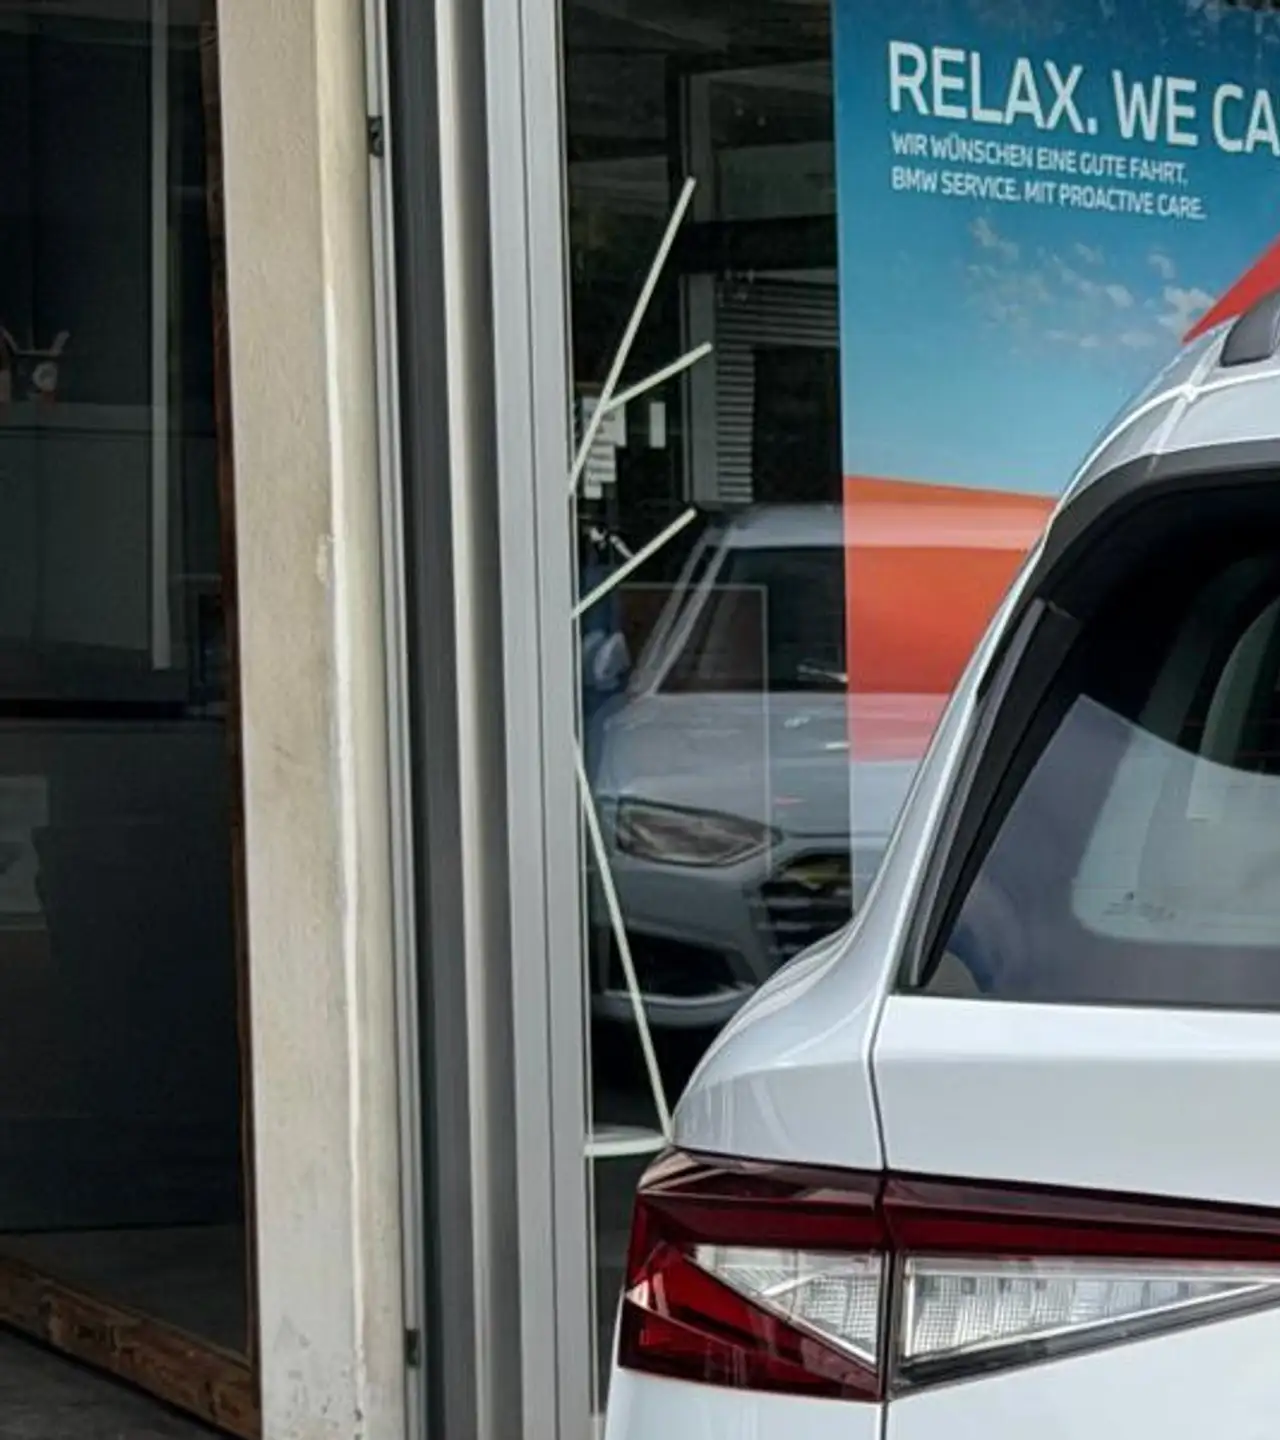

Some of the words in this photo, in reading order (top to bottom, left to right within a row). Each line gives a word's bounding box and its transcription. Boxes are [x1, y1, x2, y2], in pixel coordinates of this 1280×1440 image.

[889, 40, 1097, 135] RELAX.
[1112, 69, 1199, 146] WE
[891, 130, 928, 155] WIR
[930, 132, 1034, 169] WÜNSCHEN
[1037, 147, 1077, 173] EINE
[1080, 152, 1128, 179] GUTE
[1130, 157, 1189, 186] FAHRT.
[891, 165, 938, 193] BMW
[941, 170, 1022, 201] SERVICE.
[1025, 181, 1057, 203] MIT
[1060, 184, 1154, 215] PROACTIVE
[1157, 194, 1207, 220] CARE.
